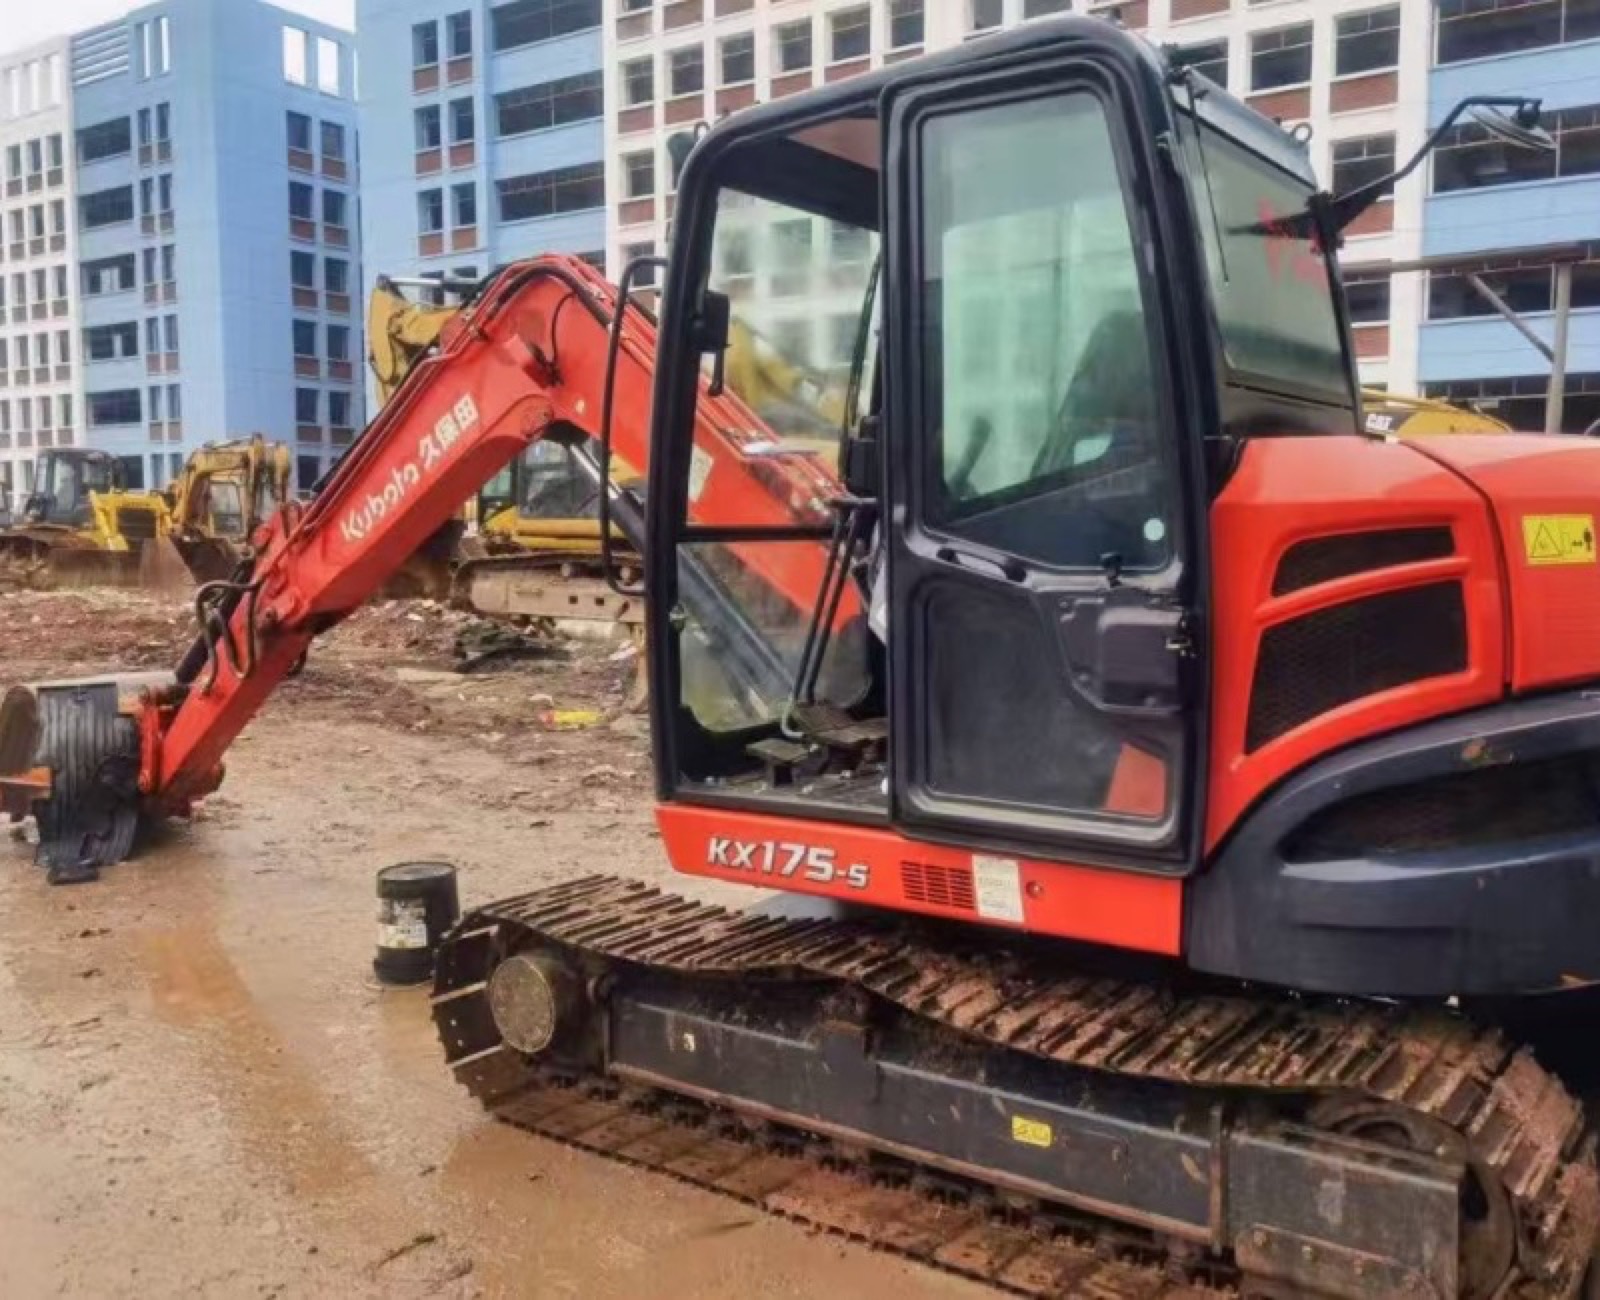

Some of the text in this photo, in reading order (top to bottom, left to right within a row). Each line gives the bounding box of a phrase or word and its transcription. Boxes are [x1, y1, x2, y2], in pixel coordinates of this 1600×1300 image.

[1365, 413, 1393, 432] CAT
[340, 392, 479, 541] Kubota 久保田
